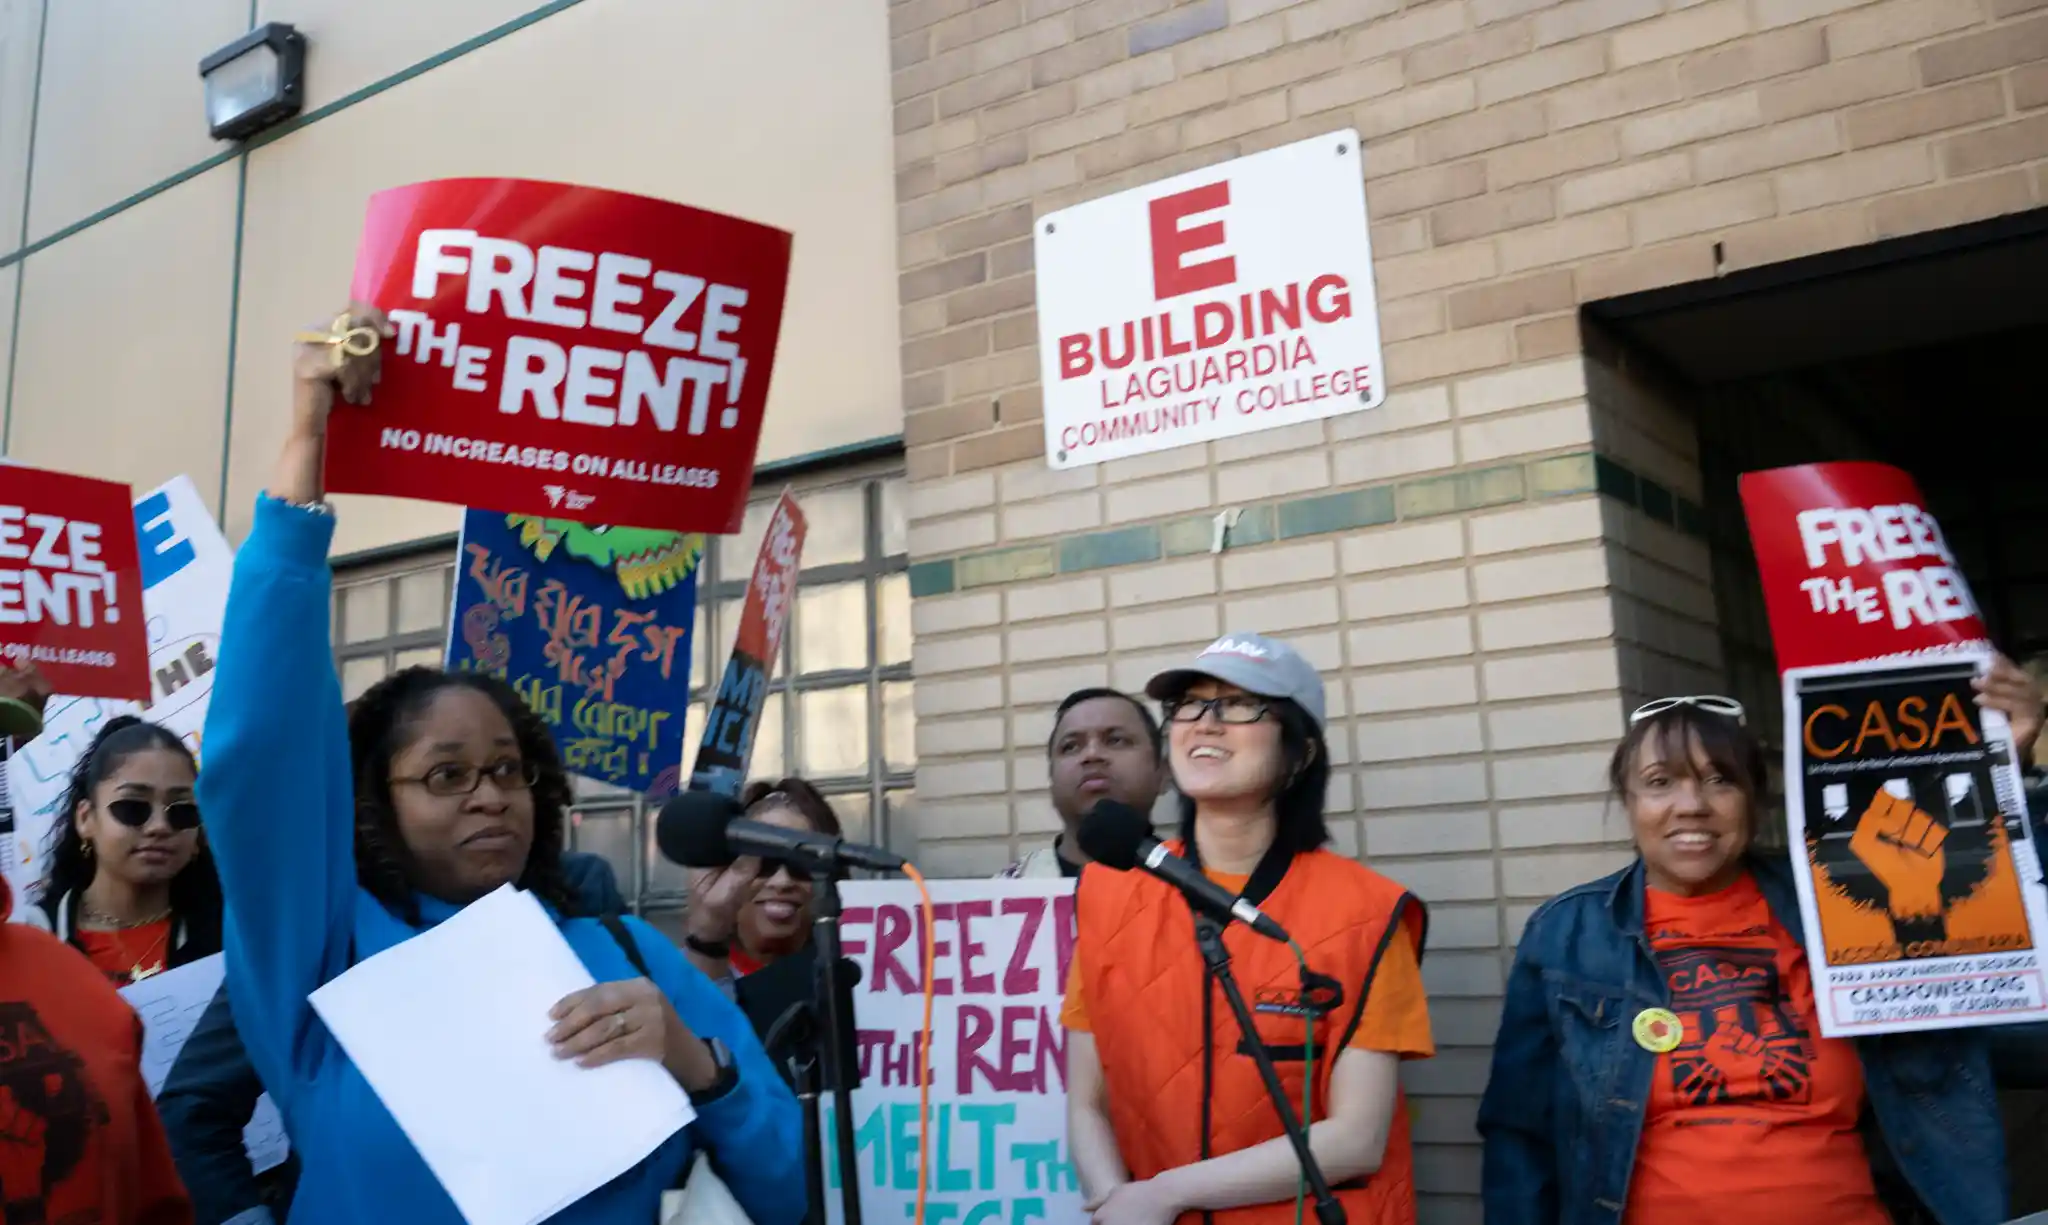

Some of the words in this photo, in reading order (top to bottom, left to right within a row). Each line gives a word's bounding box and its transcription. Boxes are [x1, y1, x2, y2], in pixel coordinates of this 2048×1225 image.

[1149, 179, 1237, 301] E
[412, 228, 749, 361] FREEZE
[1059, 273, 1352, 380] BUILDING
[388, 309, 491, 392] THE
[498, 335, 748, 436] RENT!
[1061, 396, 1221, 450] COMMUNITY
[1236, 366, 1372, 415] COLLEGE
[1101, 336, 1317, 409] LAGUARDIA
[381, 427, 420, 450] NO
[423, 432, 569, 472] INCREASES
[572, 454, 607, 476] ON
[610, 459, 649, 482] ALL
[651, 463, 720, 489] LEASES
[1796, 503, 1955, 566] FREE
[1800, 576, 1884, 624] THE
[1881, 566, 1982, 630] RE
[59, 648, 116, 668] LEASES
[142, 640, 215, 711] HE
[1803, 693, 1980, 759] CASA
[855, 1029, 934, 1087] THE
[826, 1102, 1016, 1192] MELT
